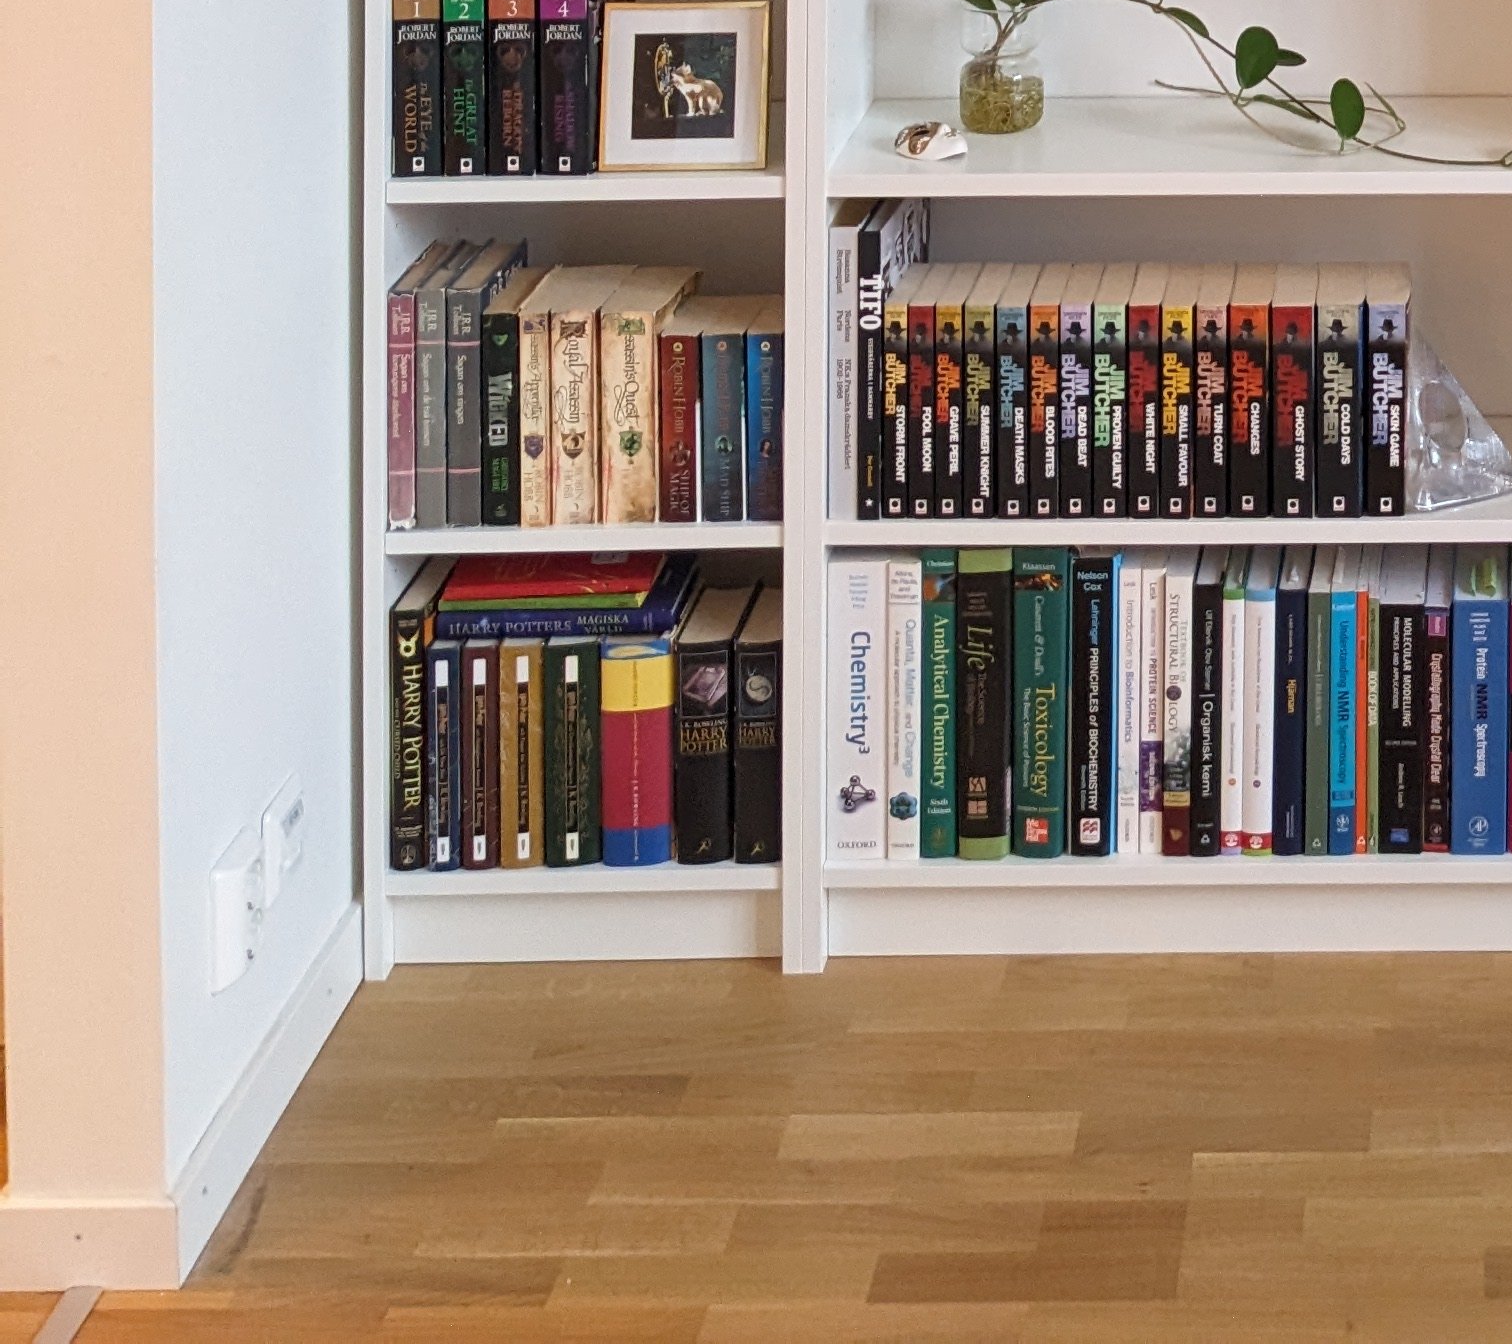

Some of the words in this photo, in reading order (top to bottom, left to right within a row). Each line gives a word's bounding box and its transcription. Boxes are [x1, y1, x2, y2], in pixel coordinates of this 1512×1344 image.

[414, 2, 420, 17] 1
[460, 2, 471, 18] 2
[507, 1, 518, 16] 3
[558, 1, 569, 17] 4
[398, 31, 437, 44] JORDAN
[402, 23, 435, 33] ROBERT
[446, 32, 482, 45] JORDAN
[451, 26, 480, 34] ROBERT
[494, 31, 532, 44] JORDAN
[498, 24, 530, 32] ROBERT
[545, 31, 583, 44] JORDAN
[549, 24, 580, 32] ROBERT
[405, 84, 418, 153] WORLD
[420, 96, 432, 131] EYE
[453, 88, 466, 137] HUNT
[466, 94, 479, 146] GREAT
[859, 274, 882, 331] TIFO
[456, 355, 467, 381] Sagan
[885, 353, 898, 417] BUTCHER
[895, 359, 906, 386] JIM
[1076, 363, 1090, 396] JIM
[1177, 363, 1191, 395] JIM
[937, 353, 950, 425] BUTCHER
[966, 354, 980, 428] BUTCHER
[1000, 355, 1013, 429] BUTCHER
[1031, 355, 1045, 433] BUTCHER
[1061, 353, 1077, 440] BUTCHER
[1094, 353, 1111, 449] BUTCHER
[1163, 353, 1178, 437] BUTCHER
[1197, 352, 1212, 436] BUTCHER
[1232, 351, 1249, 445] BUTCHER
[1323, 352, 1339, 446] BUTCHER
[1372, 352, 1389, 446] BUTCHER
[488, 371, 513, 447] WICKED
[895, 406, 907, 443] STORM
[922, 406, 932, 436] FOOL
[949, 406, 960, 441] GRAVE
[1014, 406, 1025, 442] DEATH
[1045, 405, 1056, 444] BLOOD
[1077, 405, 1088, 436] DEAD
[1111, 405, 1123, 450] PROVEN
[1145, 402, 1156, 436] WHITE
[1178, 404, 1189, 443] SMALL
[1213, 402, 1224, 435] TURN
[1295, 405, 1306, 443] GHOST
[1340, 403, 1351, 435] COLD
[1390, 404, 1401, 433] SKIN
[979, 405, 991, 451] SUMMER
[1250, 402, 1261, 456] CHANGES
[895, 444, 907, 484] FRONT
[922, 437, 932, 474] MOON
[949, 442, 960, 477] PERIL
[1014, 443, 1025, 486] MASKS
[1045, 445, 1056, 479] RITES
[1077, 437, 1088, 468] BEAT
[1145, 437, 1156, 474] NIGHT
[1178, 444, 1189, 488] FAVOUR
[1213, 435, 1224, 466] COAT
[1295, 444, 1306, 482] STORY
[1340, 436, 1351, 466] DAYS
[1390, 433, 1401, 468] GAME
[979, 452, 991, 499] KNIGHT
[1111, 450, 1123, 490] GUILTY
[1022, 561, 1057, 571] Klaassen
[1077, 571, 1109, 581] Nelson
[1083, 581, 1103, 592] Cox
[1149, 582, 1158, 601] Lesk
[449, 622, 501, 635] HARRY
[504, 619, 572, 634] POTTERS
[577, 614, 629, 626] MAGISKA
[1169, 593, 1179, 669] STRUCTURAL
[930, 614, 951, 699] Analytical
[959, 625, 995, 671] Life
[1337, 621, 1349, 688] Understanding
[1402, 617, 1413, 671] MOLECULAR
[1088, 647, 1099, 713] PRINCIPLES
[1148, 658, 1157, 695] PROTEIN
[1476, 647, 1489, 679] Protein
[402, 663, 423, 728] HARRY
[1123, 671, 1134, 743] Bioinformatics
[1338, 690, 1349, 721] NMR
[1402, 674, 1413, 727] MODELLING
[1476, 683, 1489, 719] NMR
[680, 726, 728, 742] HARRY
[739, 726, 775, 738] HARRY
[1147, 697, 1157, 734] SCIENCE
[1200, 701, 1214, 761] Organisk
[680, 739, 728, 753] POTTER
[739, 736, 775, 746] POTTER
[903, 731, 917, 778] Change
[930, 703, 951, 789] Chemistry
[1030, 683, 1056, 798] Toxicology
[402, 734, 422, 811] POTTER
[1088, 728, 1099, 811] BIOCHEMISTRY
[1201, 763, 1213, 797] kemi
[837, 840, 877, 850] OXFORD
